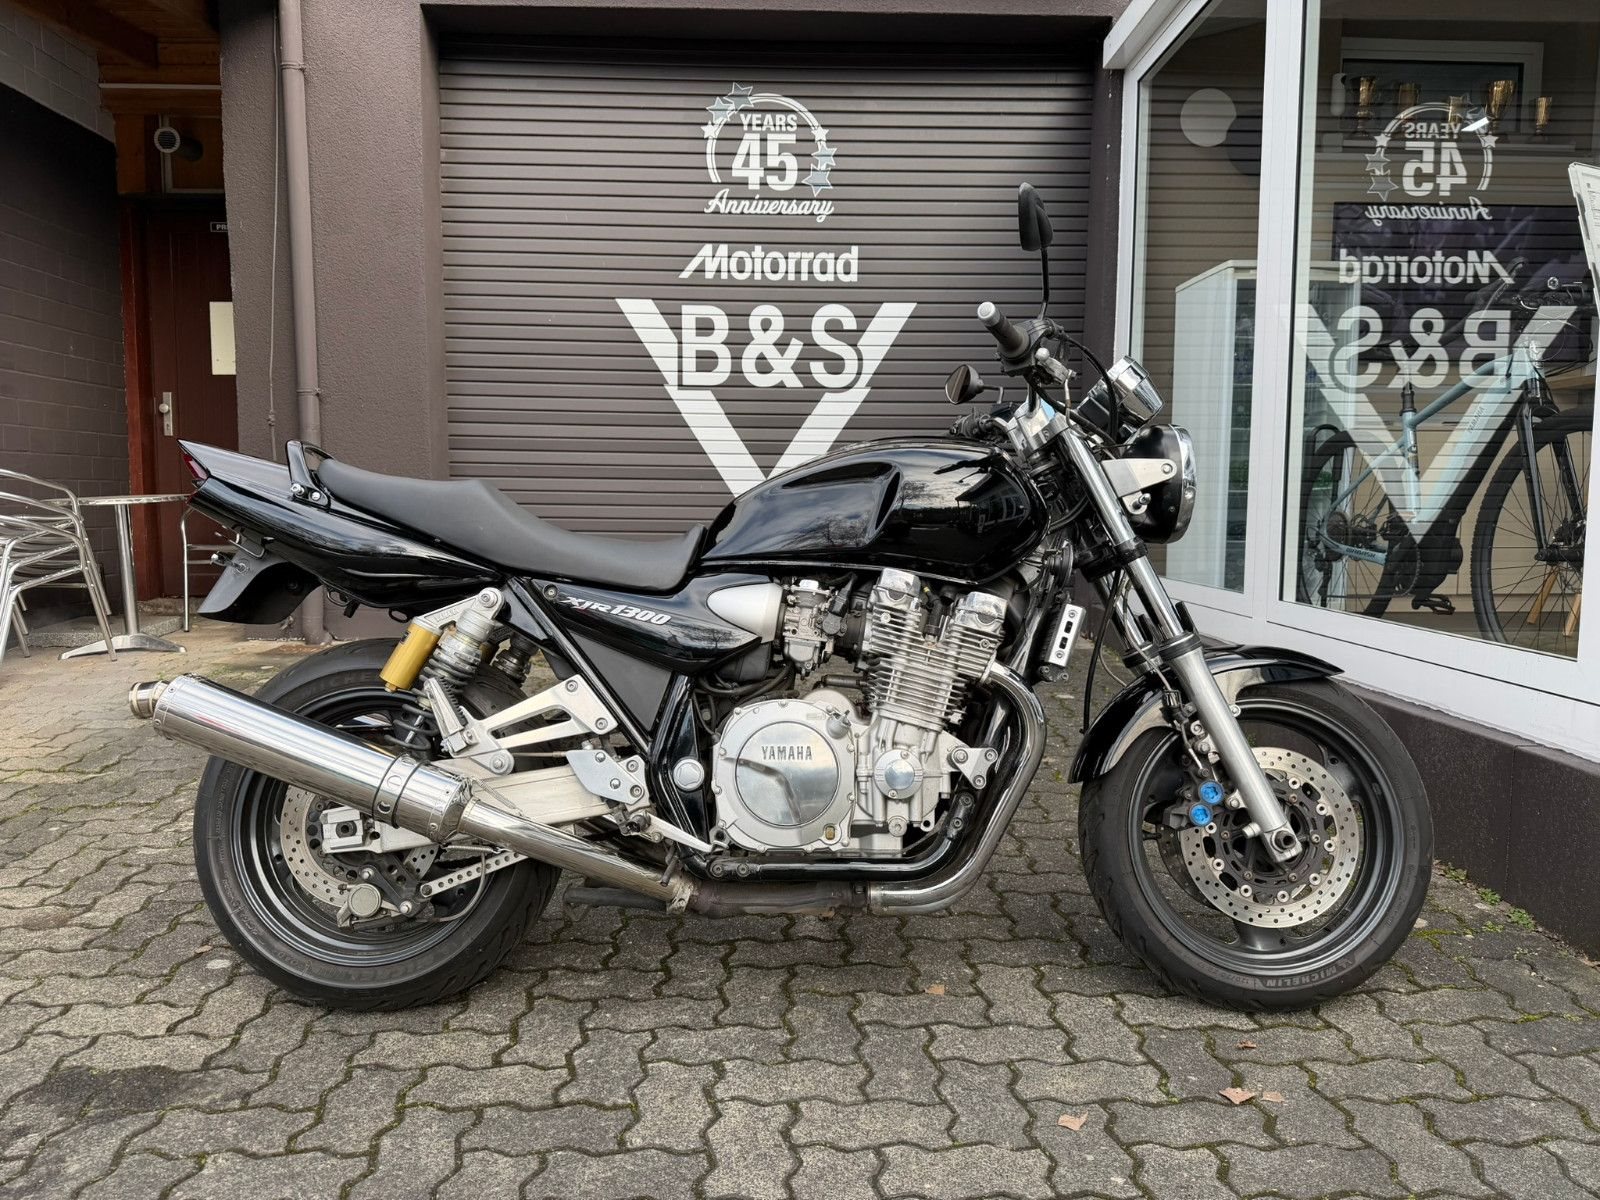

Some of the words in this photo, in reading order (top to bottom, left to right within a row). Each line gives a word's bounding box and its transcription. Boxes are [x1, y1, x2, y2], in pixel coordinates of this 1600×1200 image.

[740, 113, 797, 132] YEARS
[731, 133, 798, 191] 45
[704, 188, 834, 223] Anniversary
[678, 243, 858, 282] Motorrad
[681, 303, 858, 388] B&S
[560, 596, 672, 625] XJR1300
[761, 745, 813, 761] YAMAHA
[1265, 965, 1338, 987] MICHELIN
